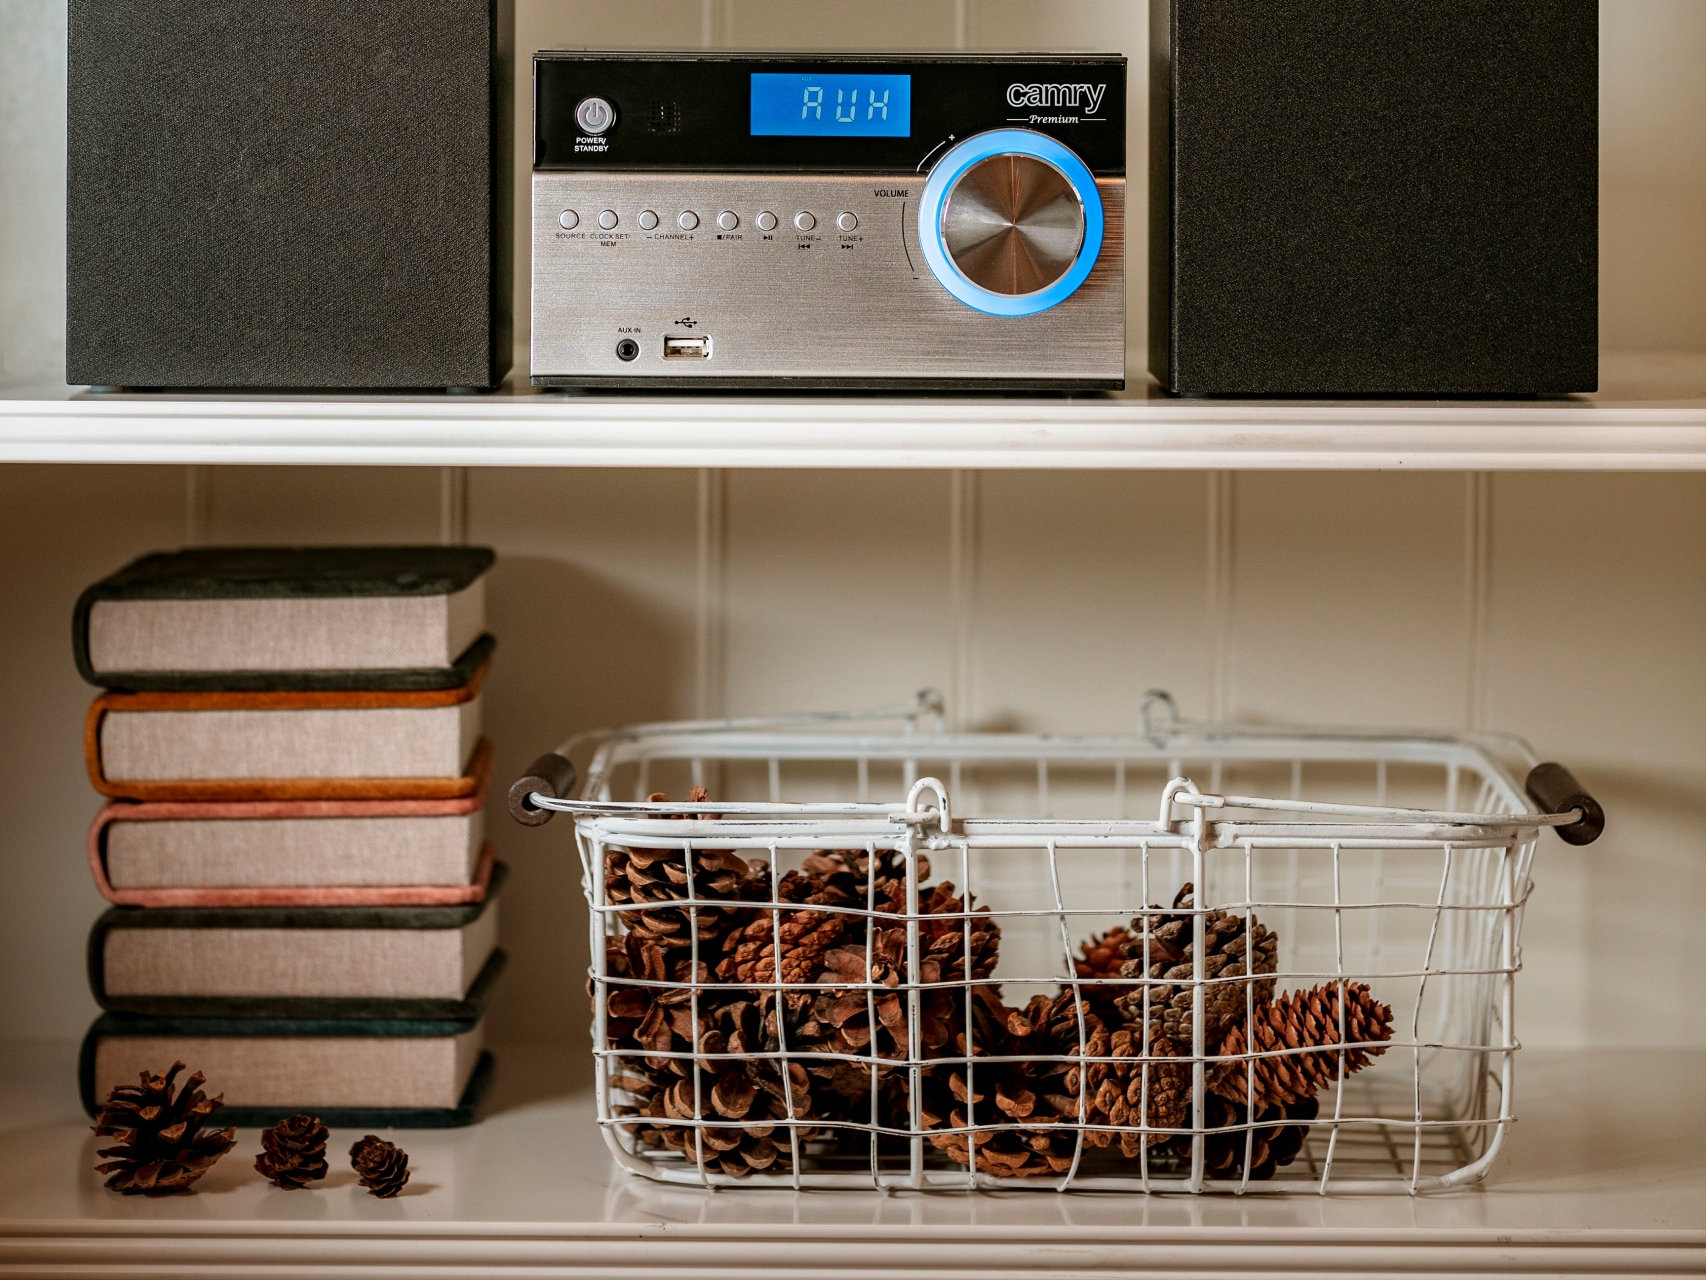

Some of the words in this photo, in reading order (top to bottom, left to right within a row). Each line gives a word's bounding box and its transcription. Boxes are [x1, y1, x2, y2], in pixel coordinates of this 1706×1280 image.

[1006, 83, 1107, 114] camry
[1029, 114, 1080, 124] Premium
[873, 189, 909, 198] VOLUME
